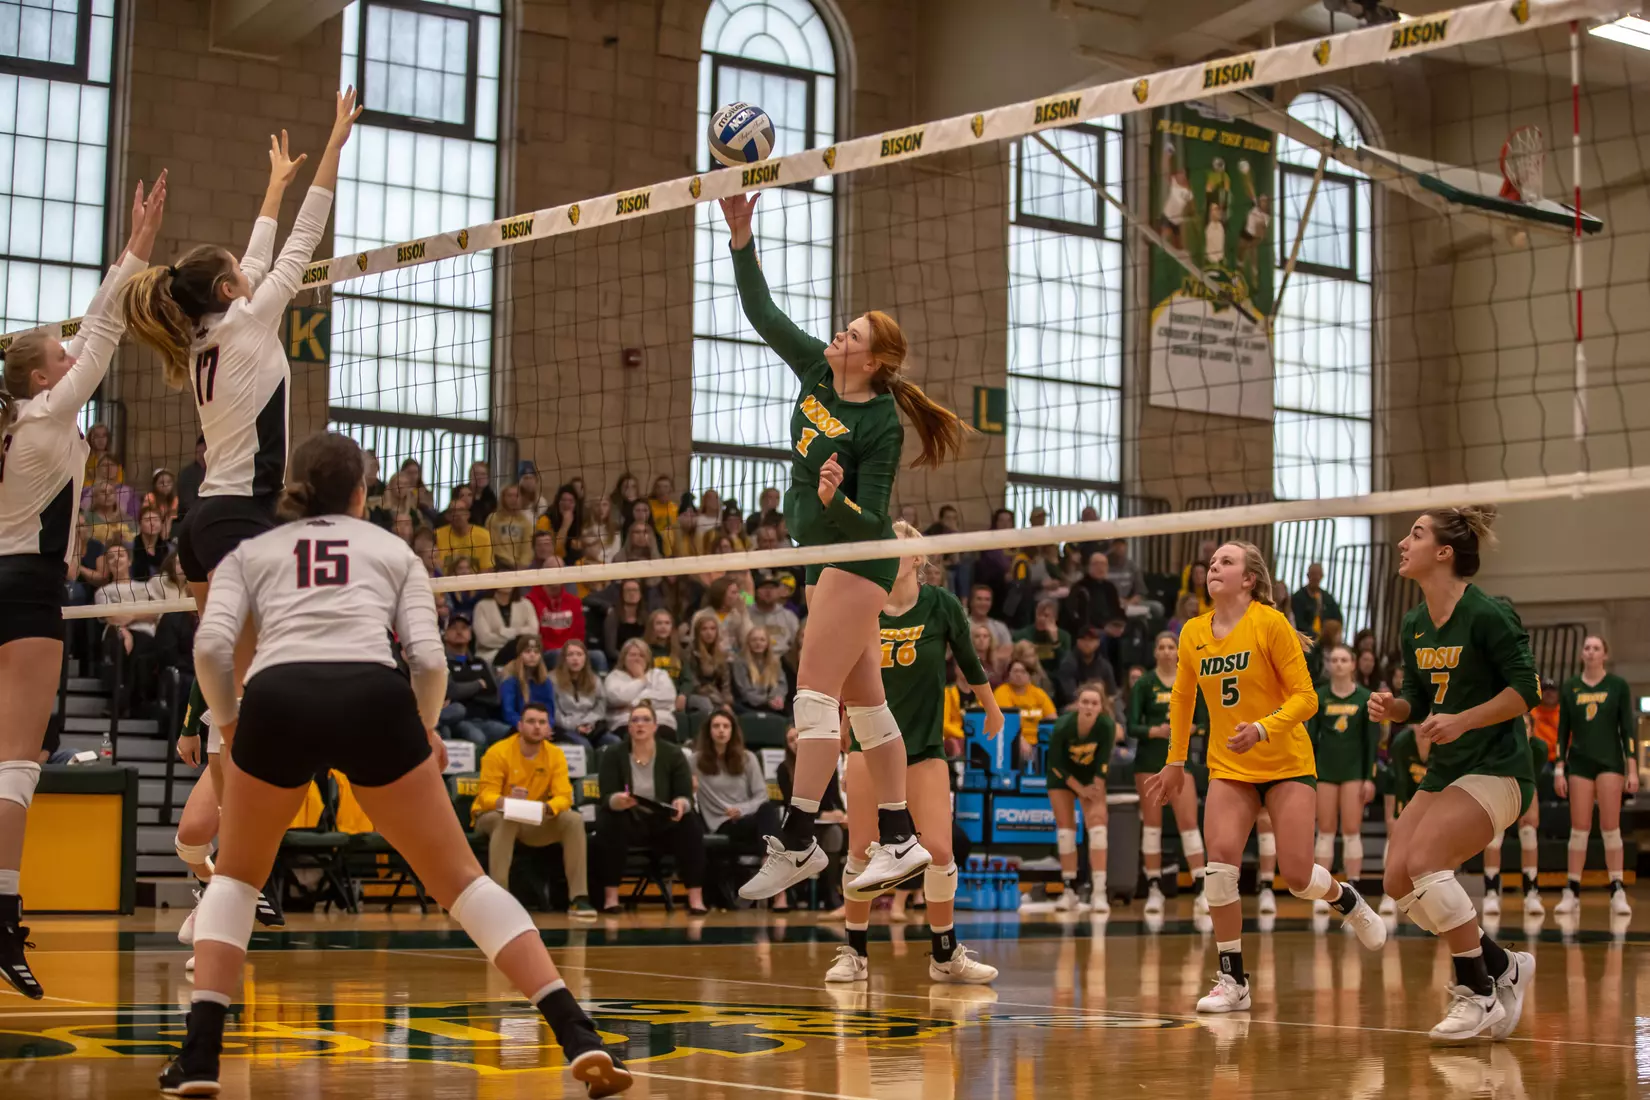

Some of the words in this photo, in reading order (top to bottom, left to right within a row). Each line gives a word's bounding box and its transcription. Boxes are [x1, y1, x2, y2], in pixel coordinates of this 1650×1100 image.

[1389, 19, 1448, 51] BISON
[1202, 59, 1256, 90] BISON
[718, 102, 748, 128] molten
[728, 108, 756, 133] NCAA
[1034, 97, 1082, 125] BISON
[880, 131, 925, 158] BISON
[742, 162, 781, 188] BISON
[615, 192, 651, 216] BISON
[501, 219, 534, 241] BISON
[397, 242, 426, 263] BISON
[302, 265, 329, 285] BISON
[291, 309, 327, 361] K
[195, 343, 220, 406] 17
[800, 394, 850, 439] NDSU
[980, 388, 1003, 431] L
[795, 426, 819, 458] 1
[293, 538, 350, 590] 15
[880, 640, 917, 669] 16
[1199, 650, 1251, 678] NDSU
[1415, 645, 1464, 670] NDSU
[1220, 674, 1241, 709] 5
[1430, 671, 1450, 705] 7
[995, 807, 1082, 824] POWER
